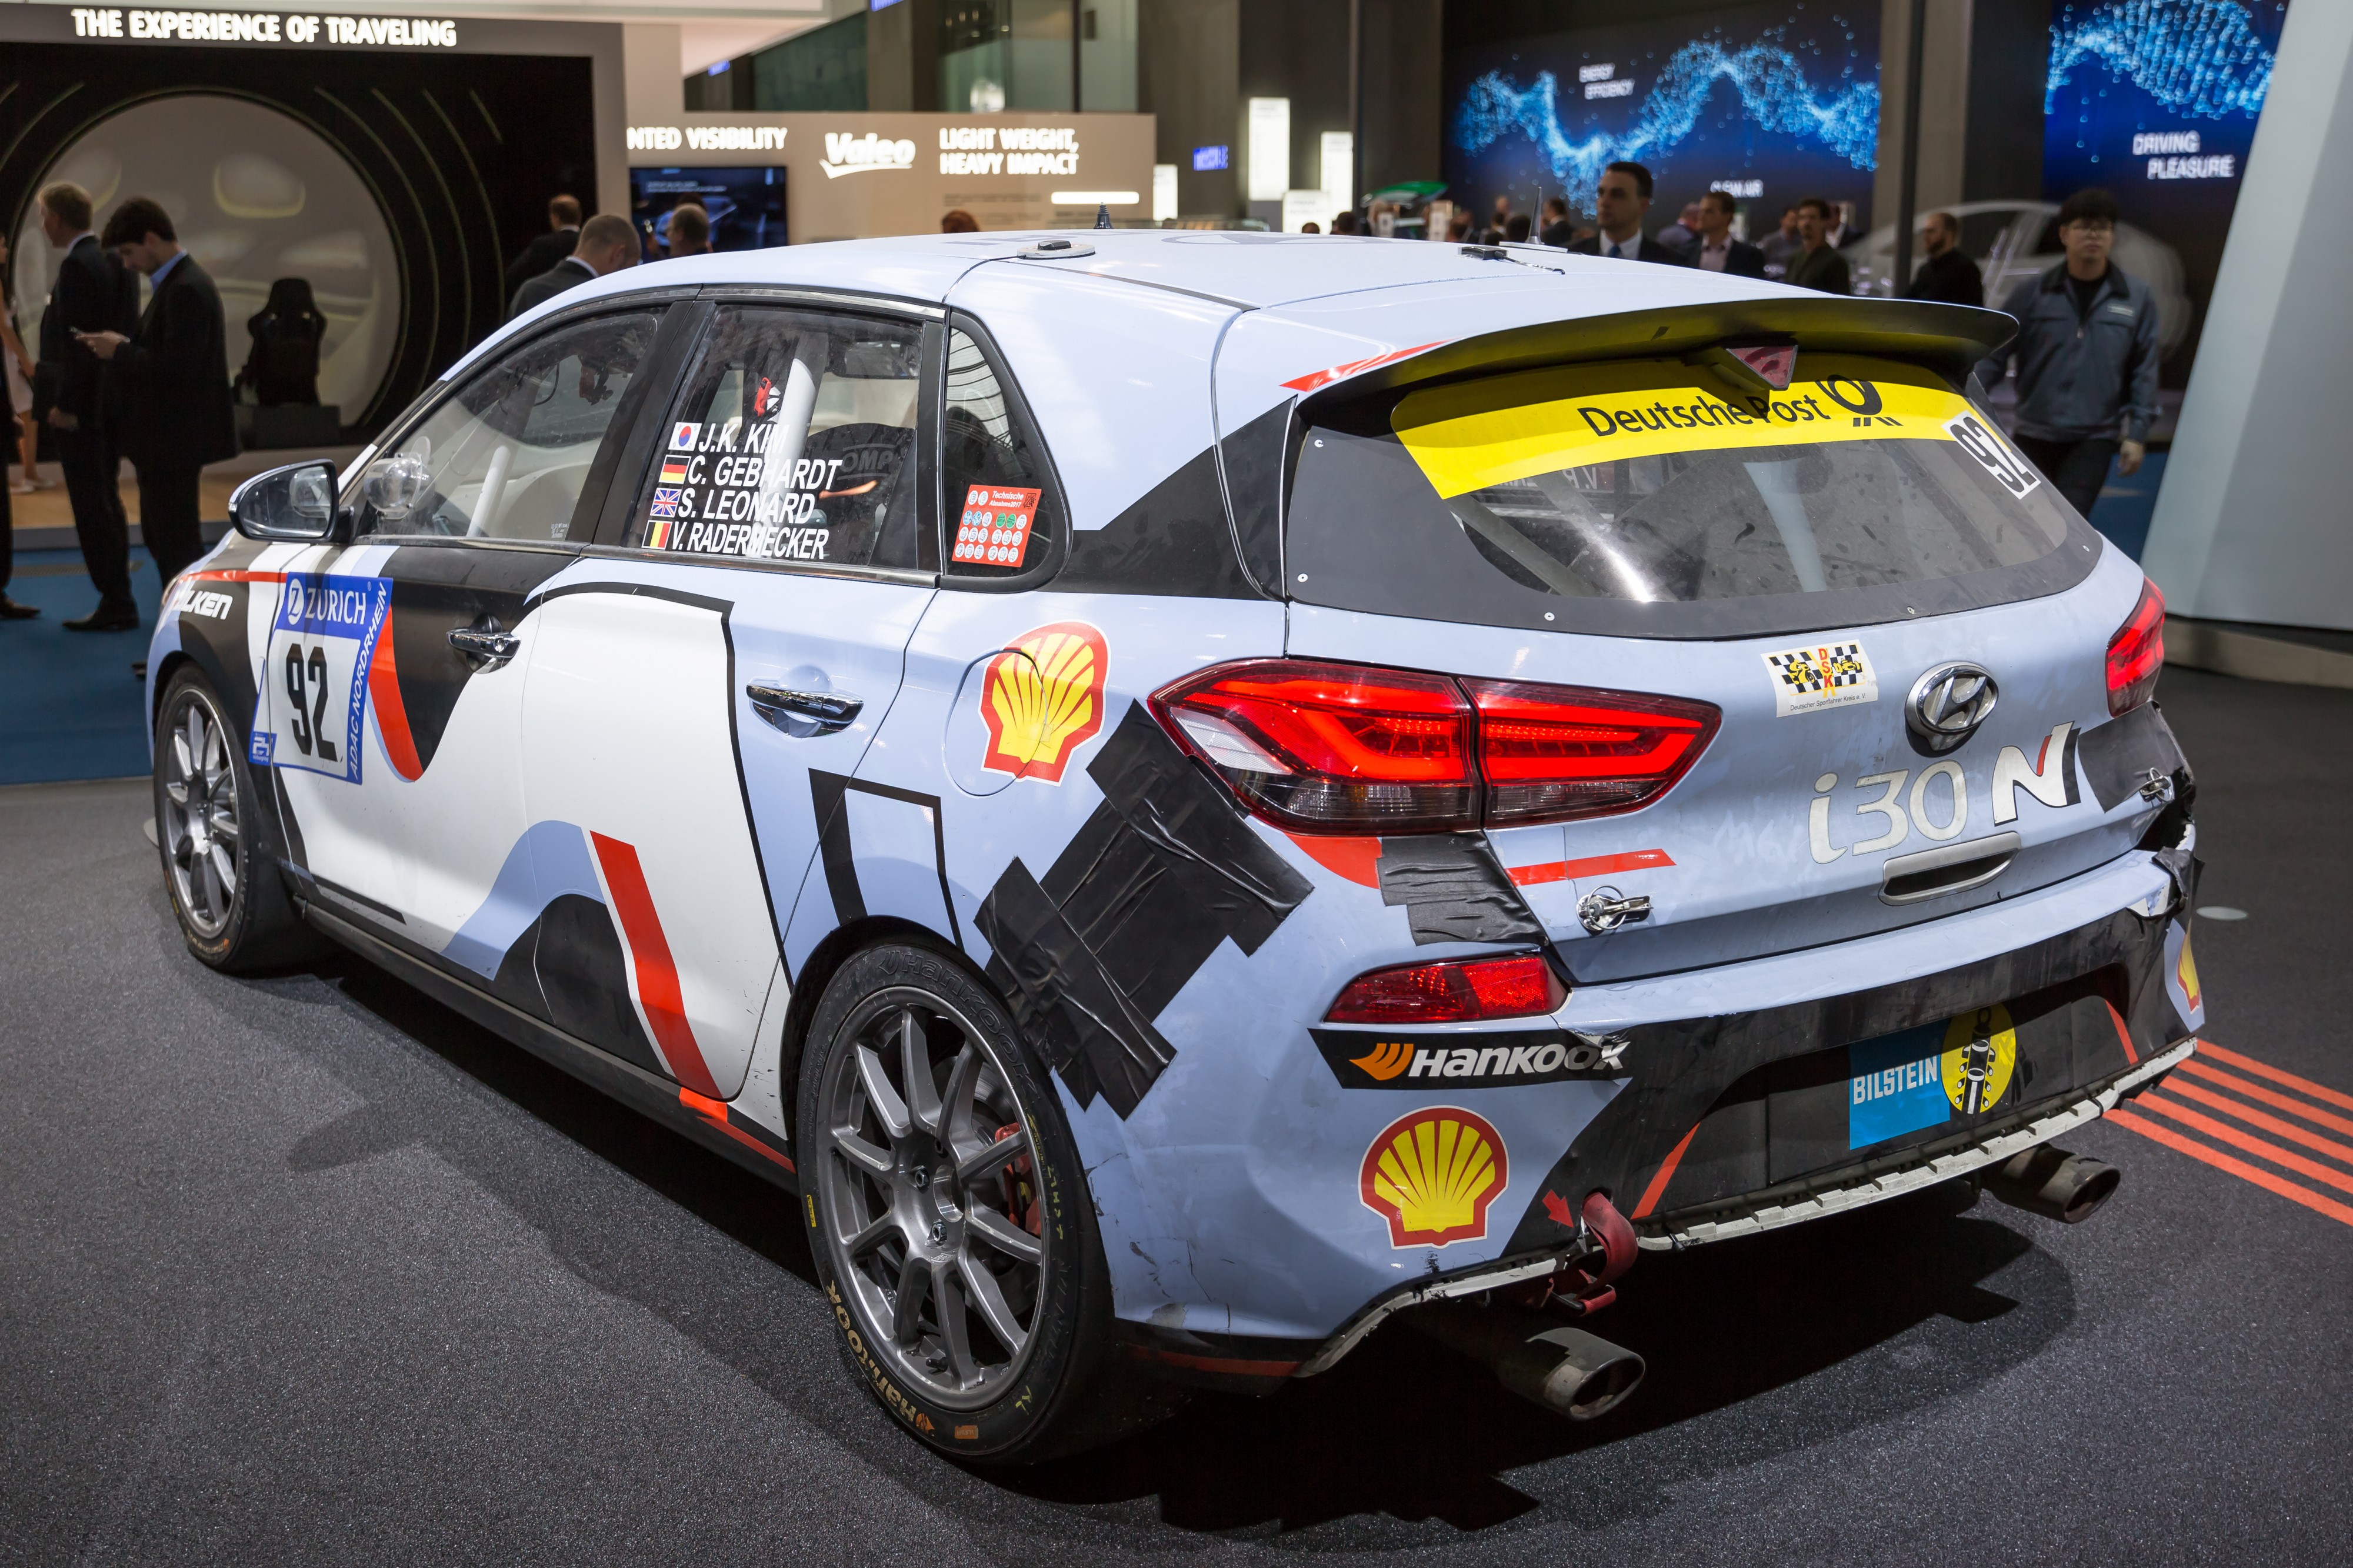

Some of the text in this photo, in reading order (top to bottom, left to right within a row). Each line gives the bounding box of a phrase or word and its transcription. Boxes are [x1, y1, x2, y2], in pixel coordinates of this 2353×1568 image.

[71, 8, 457, 47] THE EXPERIENCE OF TRAVELING
[626, 126, 788, 149] NTED VISIBILITY
[825, 132, 916, 165] Valeo
[939, 127, 1079, 154] LIGHT WEIGHT,
[2132, 130, 2201, 155] DRIVING
[940, 152, 1079, 175] HEAVY IMPACT
[2147, 154, 2235, 179] PLEASURE
[1577, 394, 1830, 437] Deutsche Post
[698, 423, 790, 453] J.K. KIM
[1950, 416, 2037, 493] 92
[688, 455, 843, 490] C. GEBHARDT
[839, 449, 894, 473] OMP
[678, 488, 815, 524] S. LEONARD
[992, 491, 1024, 500] Technische
[672, 521, 829, 559] V. RADERMECKER
[176, 589, 234, 620] LKEN
[305, 587, 366, 625] ZURICH
[349, 581, 388, 781] ADAC NORDRHEIN
[286, 643, 338, 763] 92
[1790, 702, 1815, 711] Deutscher
[1816, 697, 1842, 707] Sportfahrer
[1808, 720, 2081, 864] i30 N
[1853, 1056, 1938, 1105] BILSTEIN
